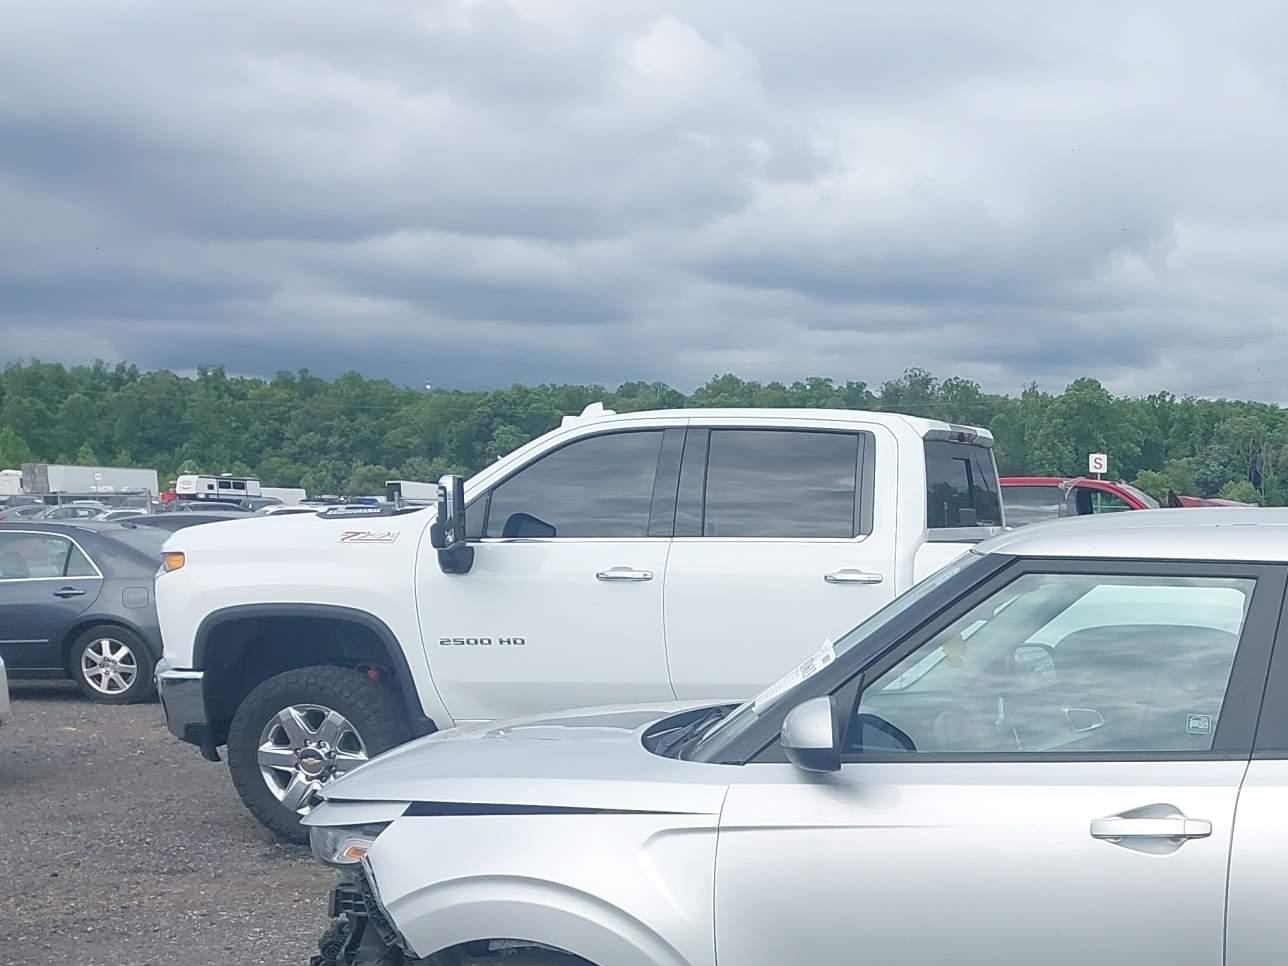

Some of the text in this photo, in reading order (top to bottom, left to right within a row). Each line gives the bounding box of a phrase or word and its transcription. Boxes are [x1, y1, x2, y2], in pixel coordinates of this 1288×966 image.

[1093, 457, 1103, 470] S
[439, 637, 525, 646] 2500 HD
